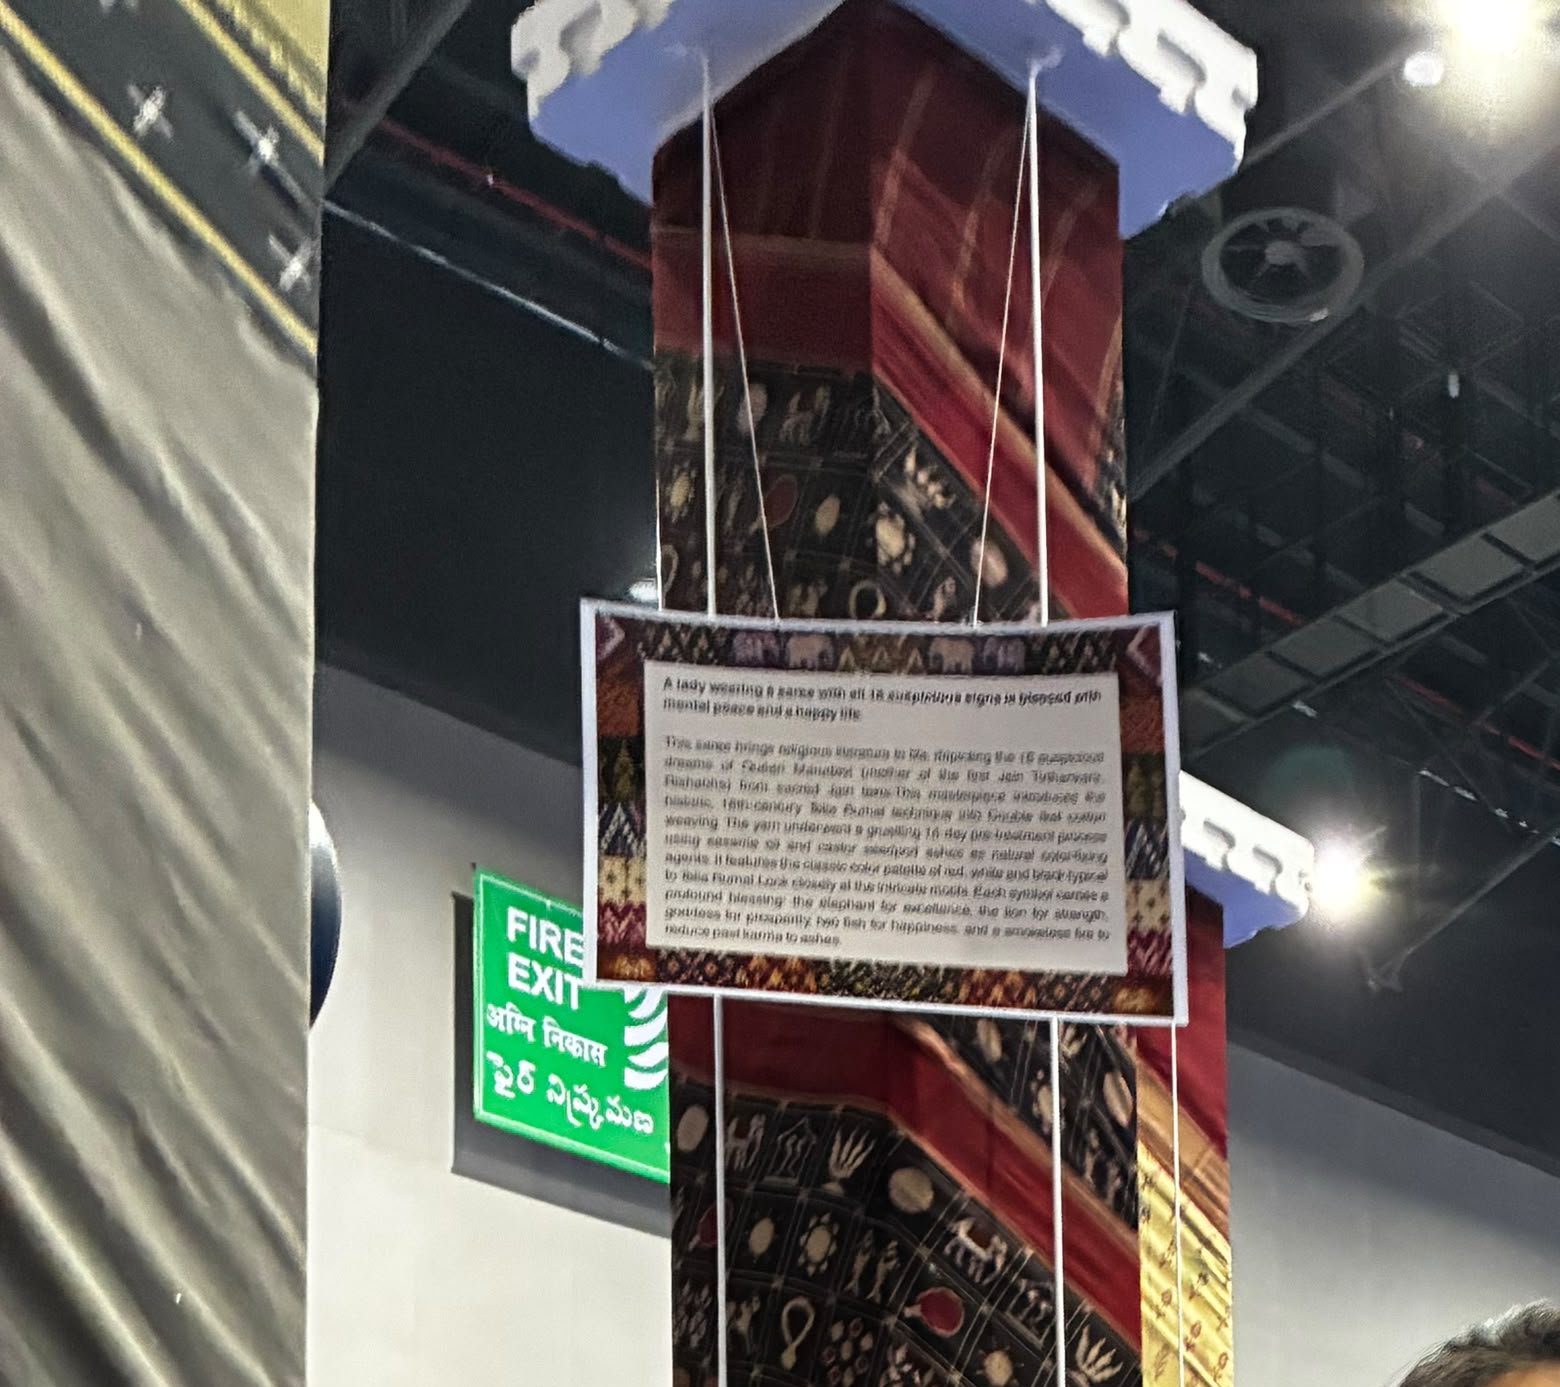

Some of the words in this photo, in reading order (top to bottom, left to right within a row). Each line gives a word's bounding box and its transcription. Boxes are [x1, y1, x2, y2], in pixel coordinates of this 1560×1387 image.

[507, 906, 584, 968] FIRE
[507, 952, 584, 1010] EXIT
[486, 1002, 536, 1043] अग्नि
[542, 1016, 608, 1067] निकास
